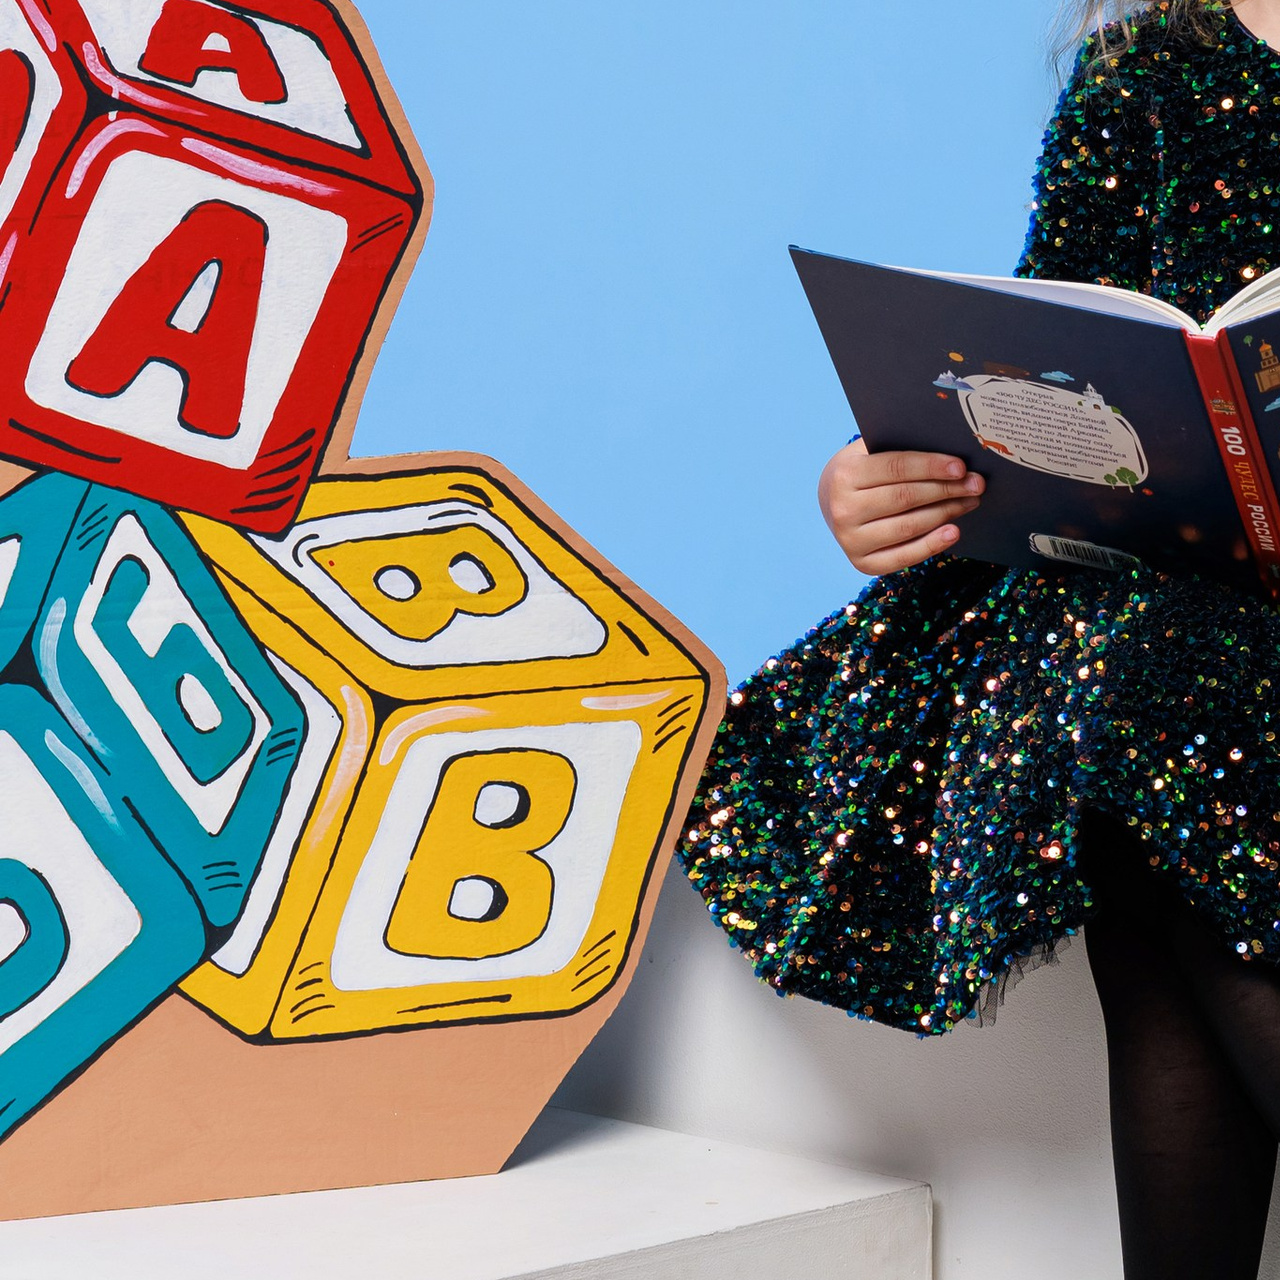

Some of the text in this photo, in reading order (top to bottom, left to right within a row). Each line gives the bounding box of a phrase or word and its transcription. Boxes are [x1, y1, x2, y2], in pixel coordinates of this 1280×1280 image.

[1015, 395, 1041, 403] ЧУДЕС
[1220, 426, 1276, 552] 100 ЧУДЕС РОССИИ
